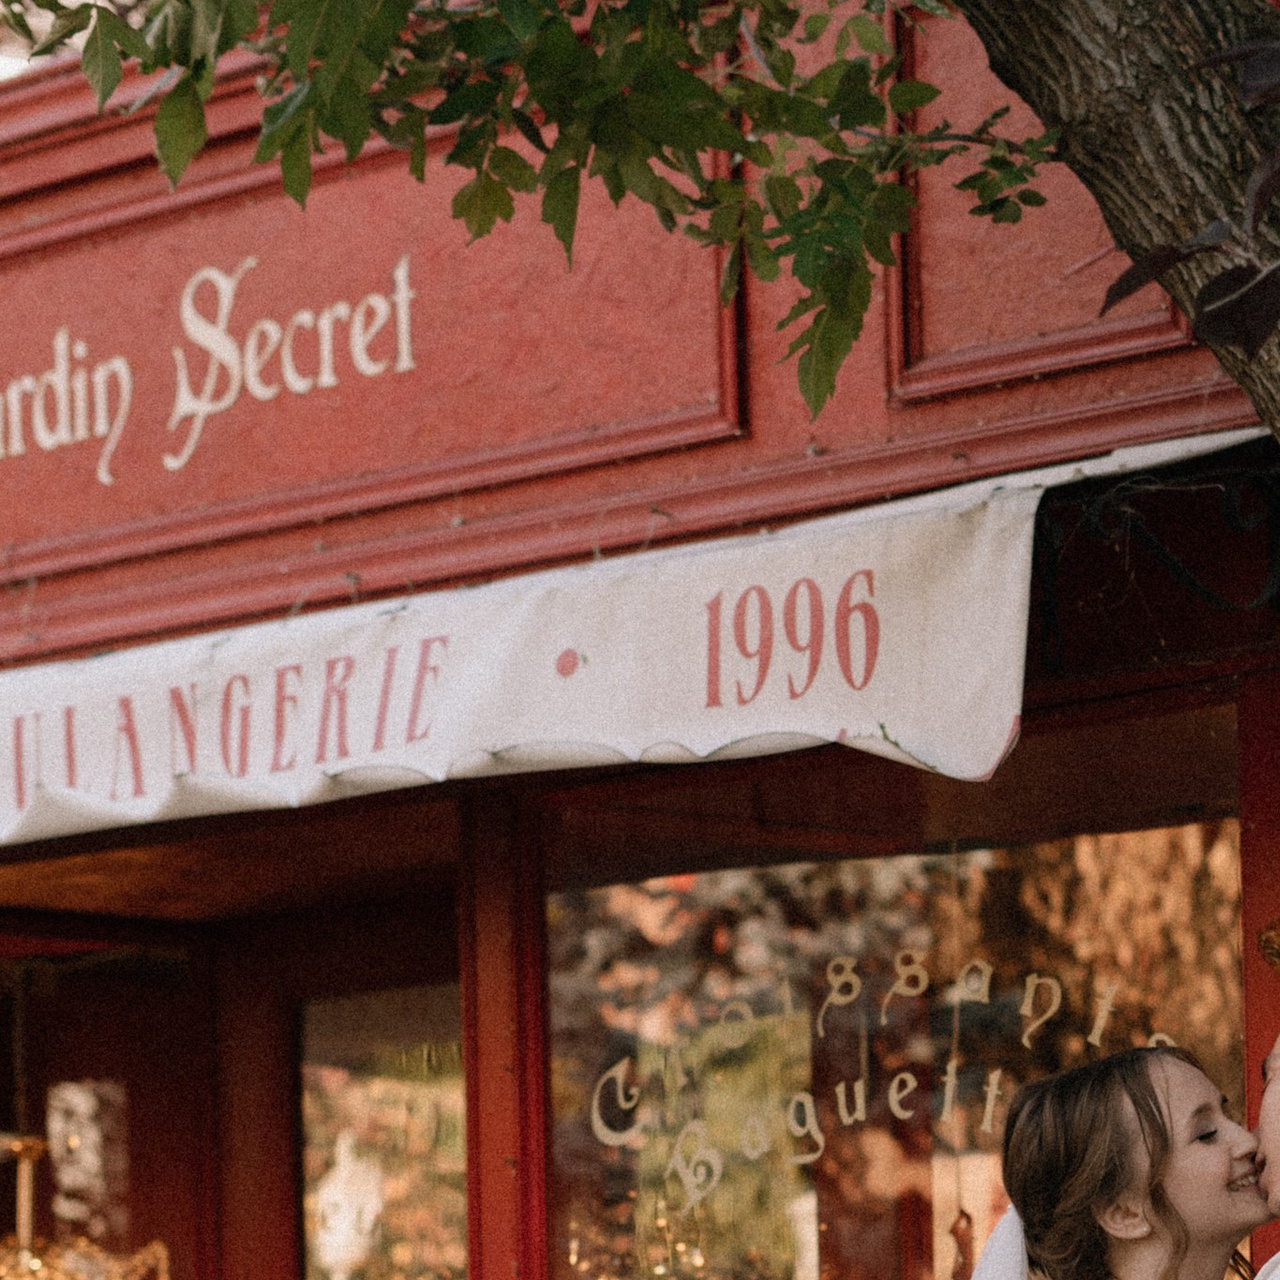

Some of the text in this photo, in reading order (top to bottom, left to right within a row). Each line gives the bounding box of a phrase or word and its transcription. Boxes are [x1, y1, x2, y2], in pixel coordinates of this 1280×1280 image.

[0, 253, 418, 485] rdin Secret
[705, 568, 881, 708] 1996
